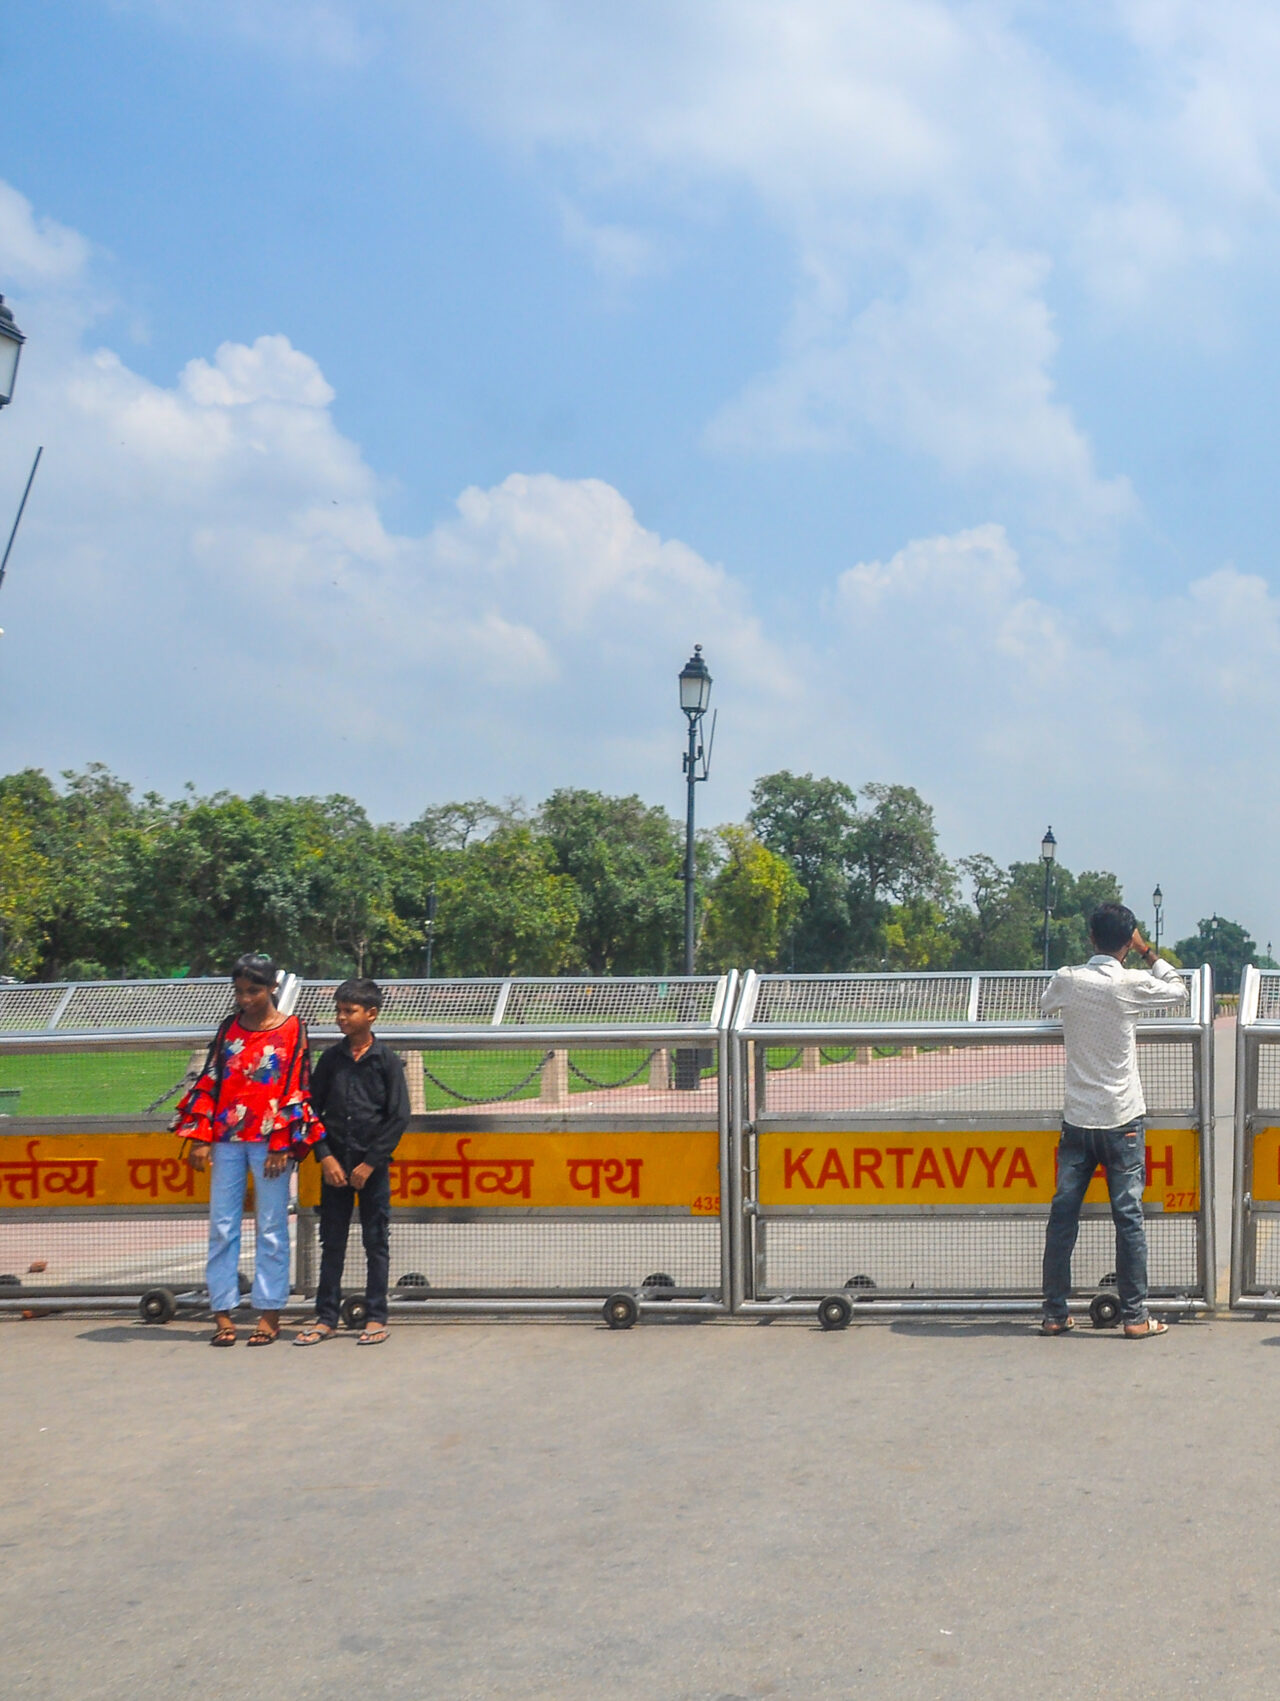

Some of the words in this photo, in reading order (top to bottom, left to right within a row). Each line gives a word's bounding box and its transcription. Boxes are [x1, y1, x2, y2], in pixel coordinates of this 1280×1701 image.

[0, 1140, 99, 1200] र्त्तव्य
[127, 1157, 195, 1198] पथ
[566, 1157, 644, 1199] पथ
[783, 1146, 1038, 1190] KARTAVYA
[1165, 1192, 1197, 1208] 277
